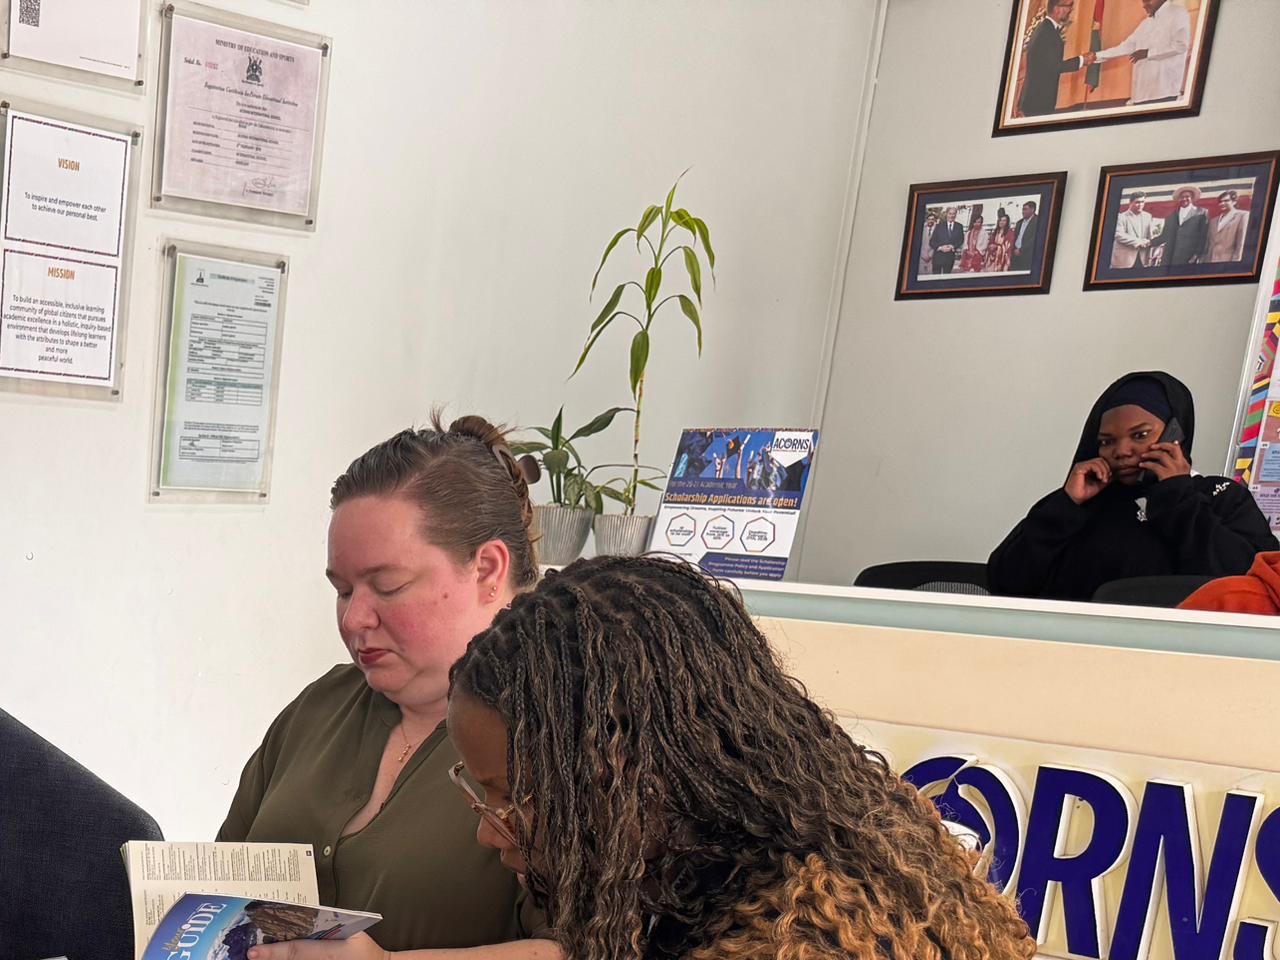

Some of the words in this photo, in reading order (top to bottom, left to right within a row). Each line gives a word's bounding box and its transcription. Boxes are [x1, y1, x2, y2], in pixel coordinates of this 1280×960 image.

[215, 39, 236, 49] MINISTRY
[244, 45, 269, 55] EDUCATION
[58, 158, 80, 171] VISION
[31, 194, 47, 202] inspire
[59, 199, 81, 208] empower
[94, 205, 106, 213] other
[38, 204, 56, 213] achieve
[65, 210, 86, 219] personal
[47, 267, 76, 280] MISSION
[20, 295, 32, 304] build
[65, 303, 84, 311] inclusive
[85, 304, 105, 314] learning
[9, 305, 37, 315] community
[44, 308, 59, 316] global
[60, 311, 77, 319] citizens
[87, 315, 106, 323] pursues
[3, 313, 26, 322] academic
[27, 315, 52, 325] excellence
[80, 322, 97, 331] inquiry
[97, 324, 111, 332] based
[7, 323, 38, 332] environment
[38, 326, 49, 334] that
[49, 328, 70, 337] develops
[88, 333, 107, 341] learners
[36, 336, 59, 344] attributes
[65, 339, 79, 347] shape
[38, 355, 58, 363] peaceful
[773, 437, 810, 450] ACORNS
[664, 492, 708, 503] Scholarship
[708, 493, 757, 505] Applications
[758, 496, 771, 505] are
[772, 495, 799, 507] open!
